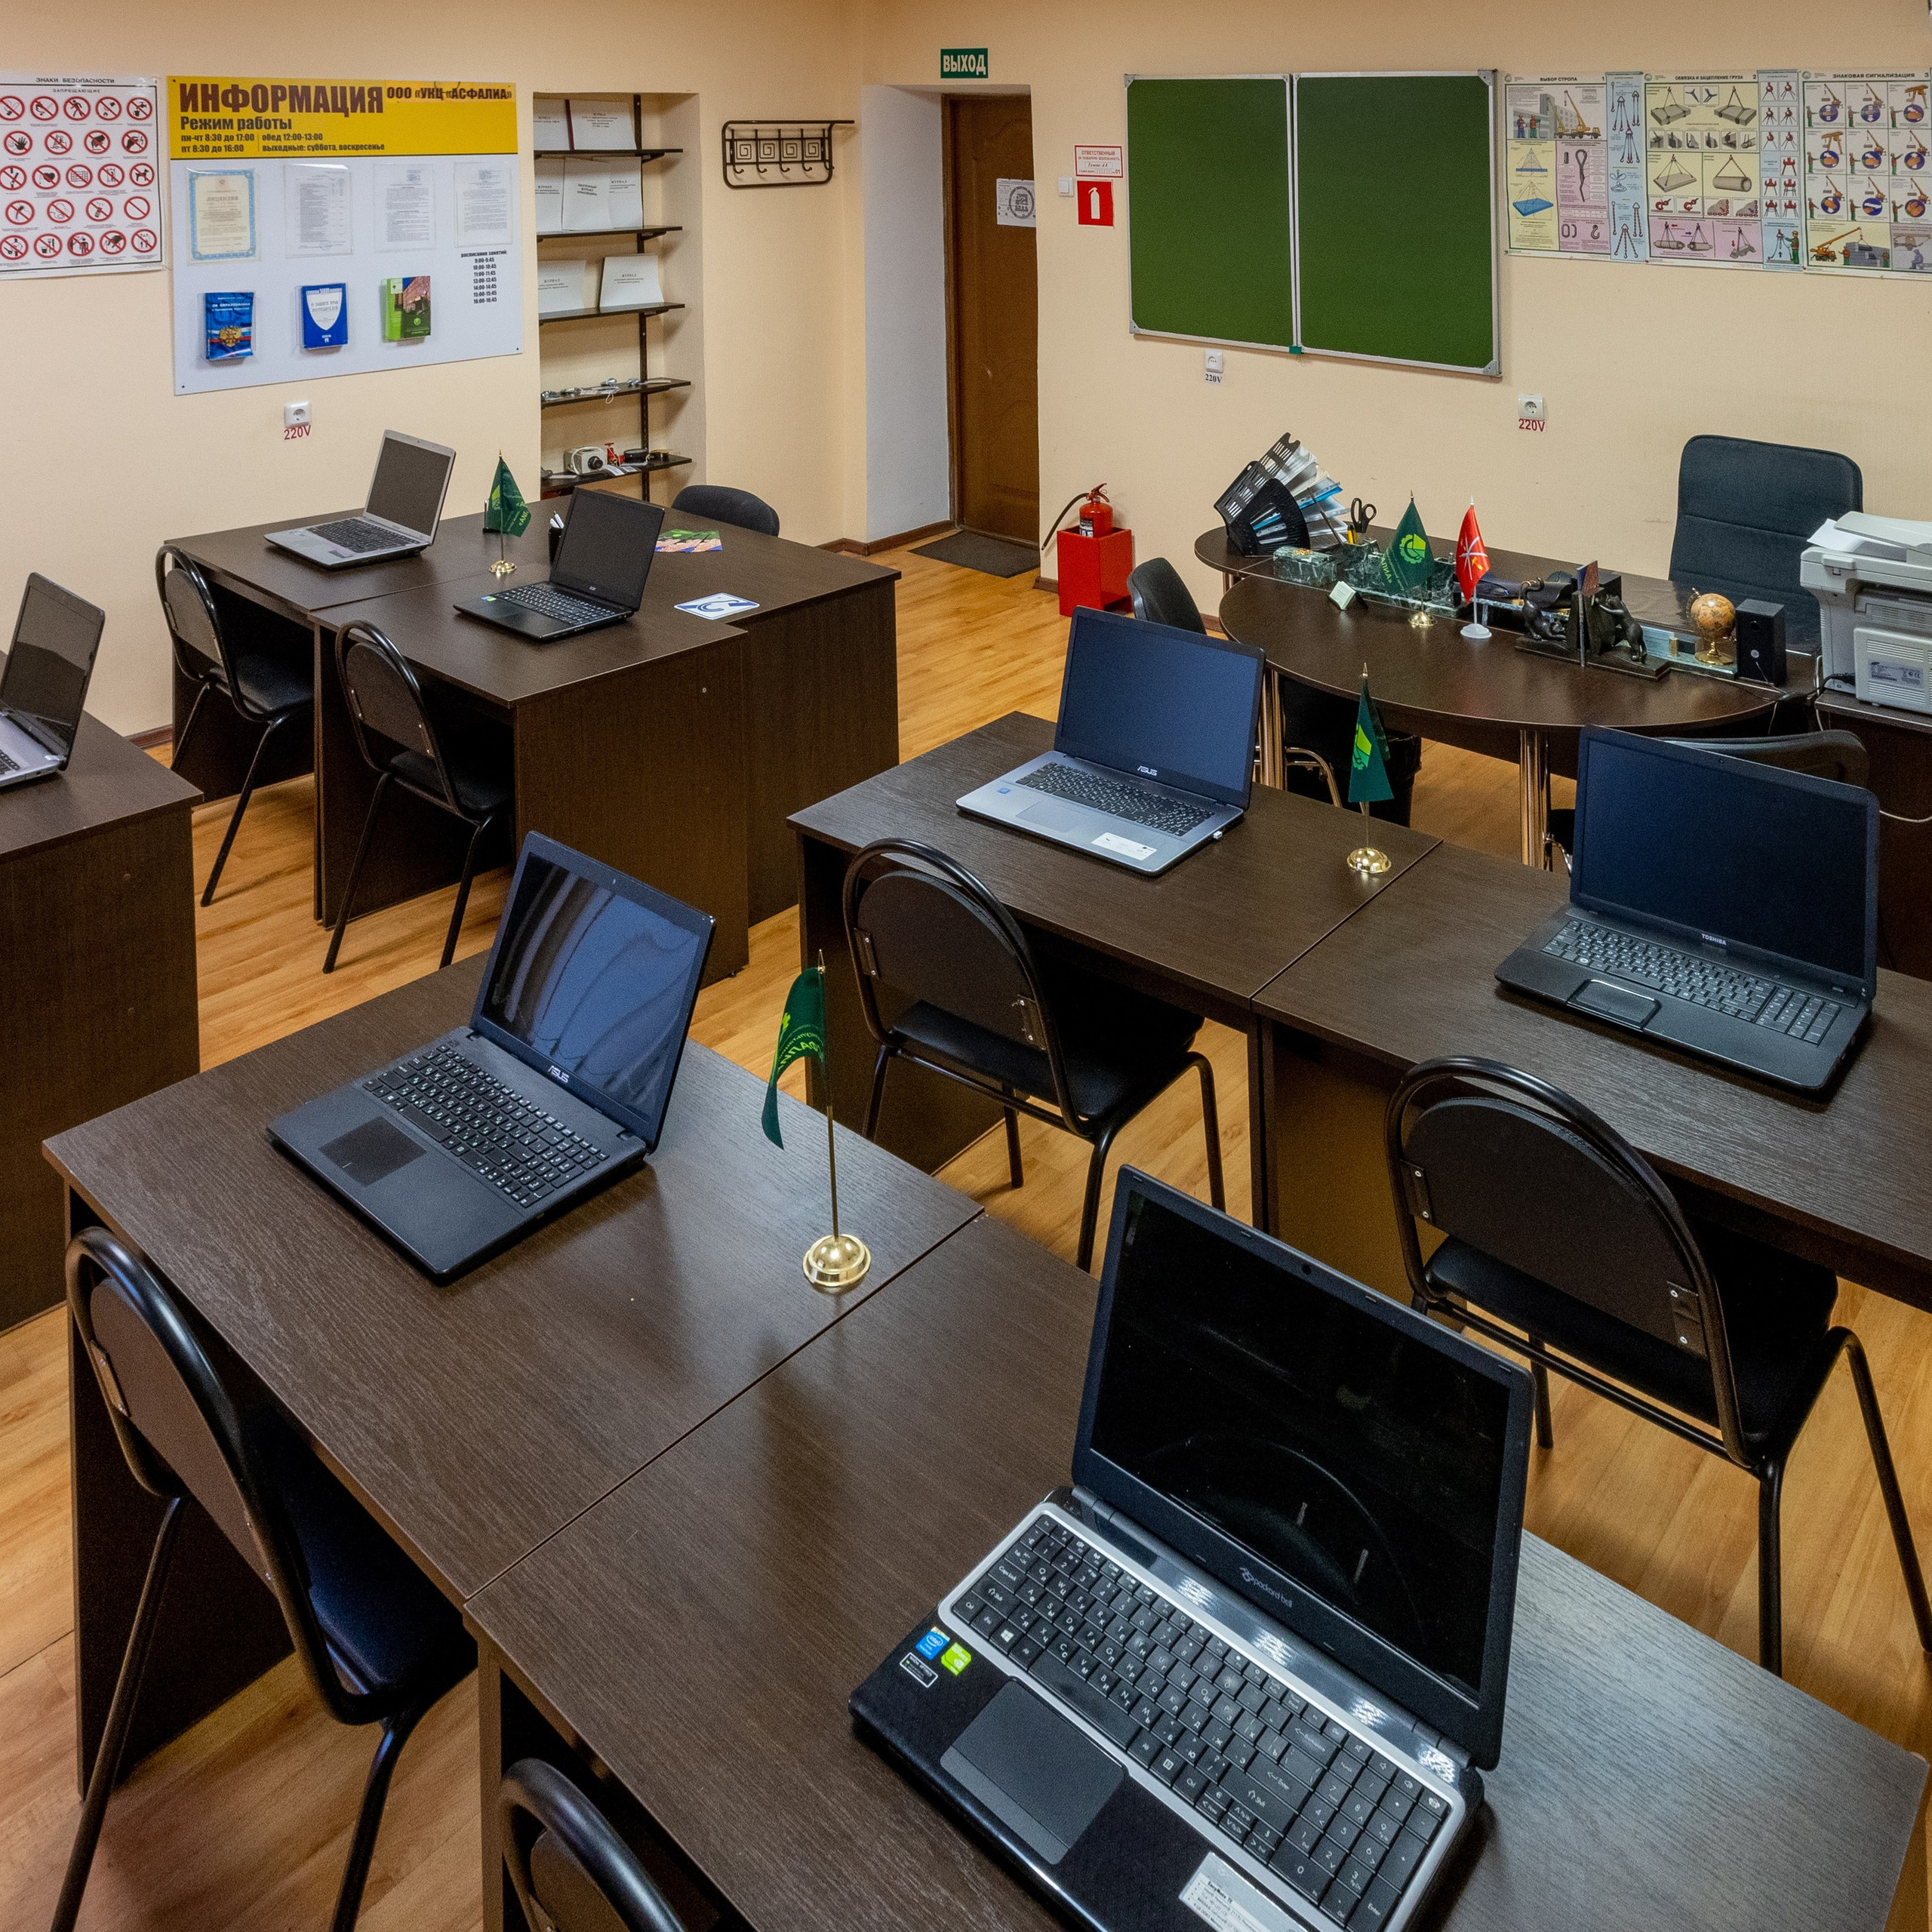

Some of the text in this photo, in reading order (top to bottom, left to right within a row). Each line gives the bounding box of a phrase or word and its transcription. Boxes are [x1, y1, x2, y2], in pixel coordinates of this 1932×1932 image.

[943, 54, 986, 75] ВЫХОД
[387, 87, 512, 100] ООО «УКЦ «АСФАЛИА»
[179, 83, 383, 118] ИНФОРМАЦИЯ
[180, 116, 292, 131] Режим работы
[1205, 374, 1223, 383] 220V
[1518, 418, 1545, 432] 220V
[284, 425, 311, 440] 220V
[1137, 765, 1158, 777] ASUS
[1701, 933, 1727, 946] TOSHIBA
[547, 1065, 570, 1084] ASUS
[1121, 1690, 1128, 1699] N
[1142, 1707, 1150, 1715] M
[1297, 1866, 1304, 1874] 0
[1352, 1871, 1358, 1879] 3
[1205, 1881, 1228, 1900] EasyNote
